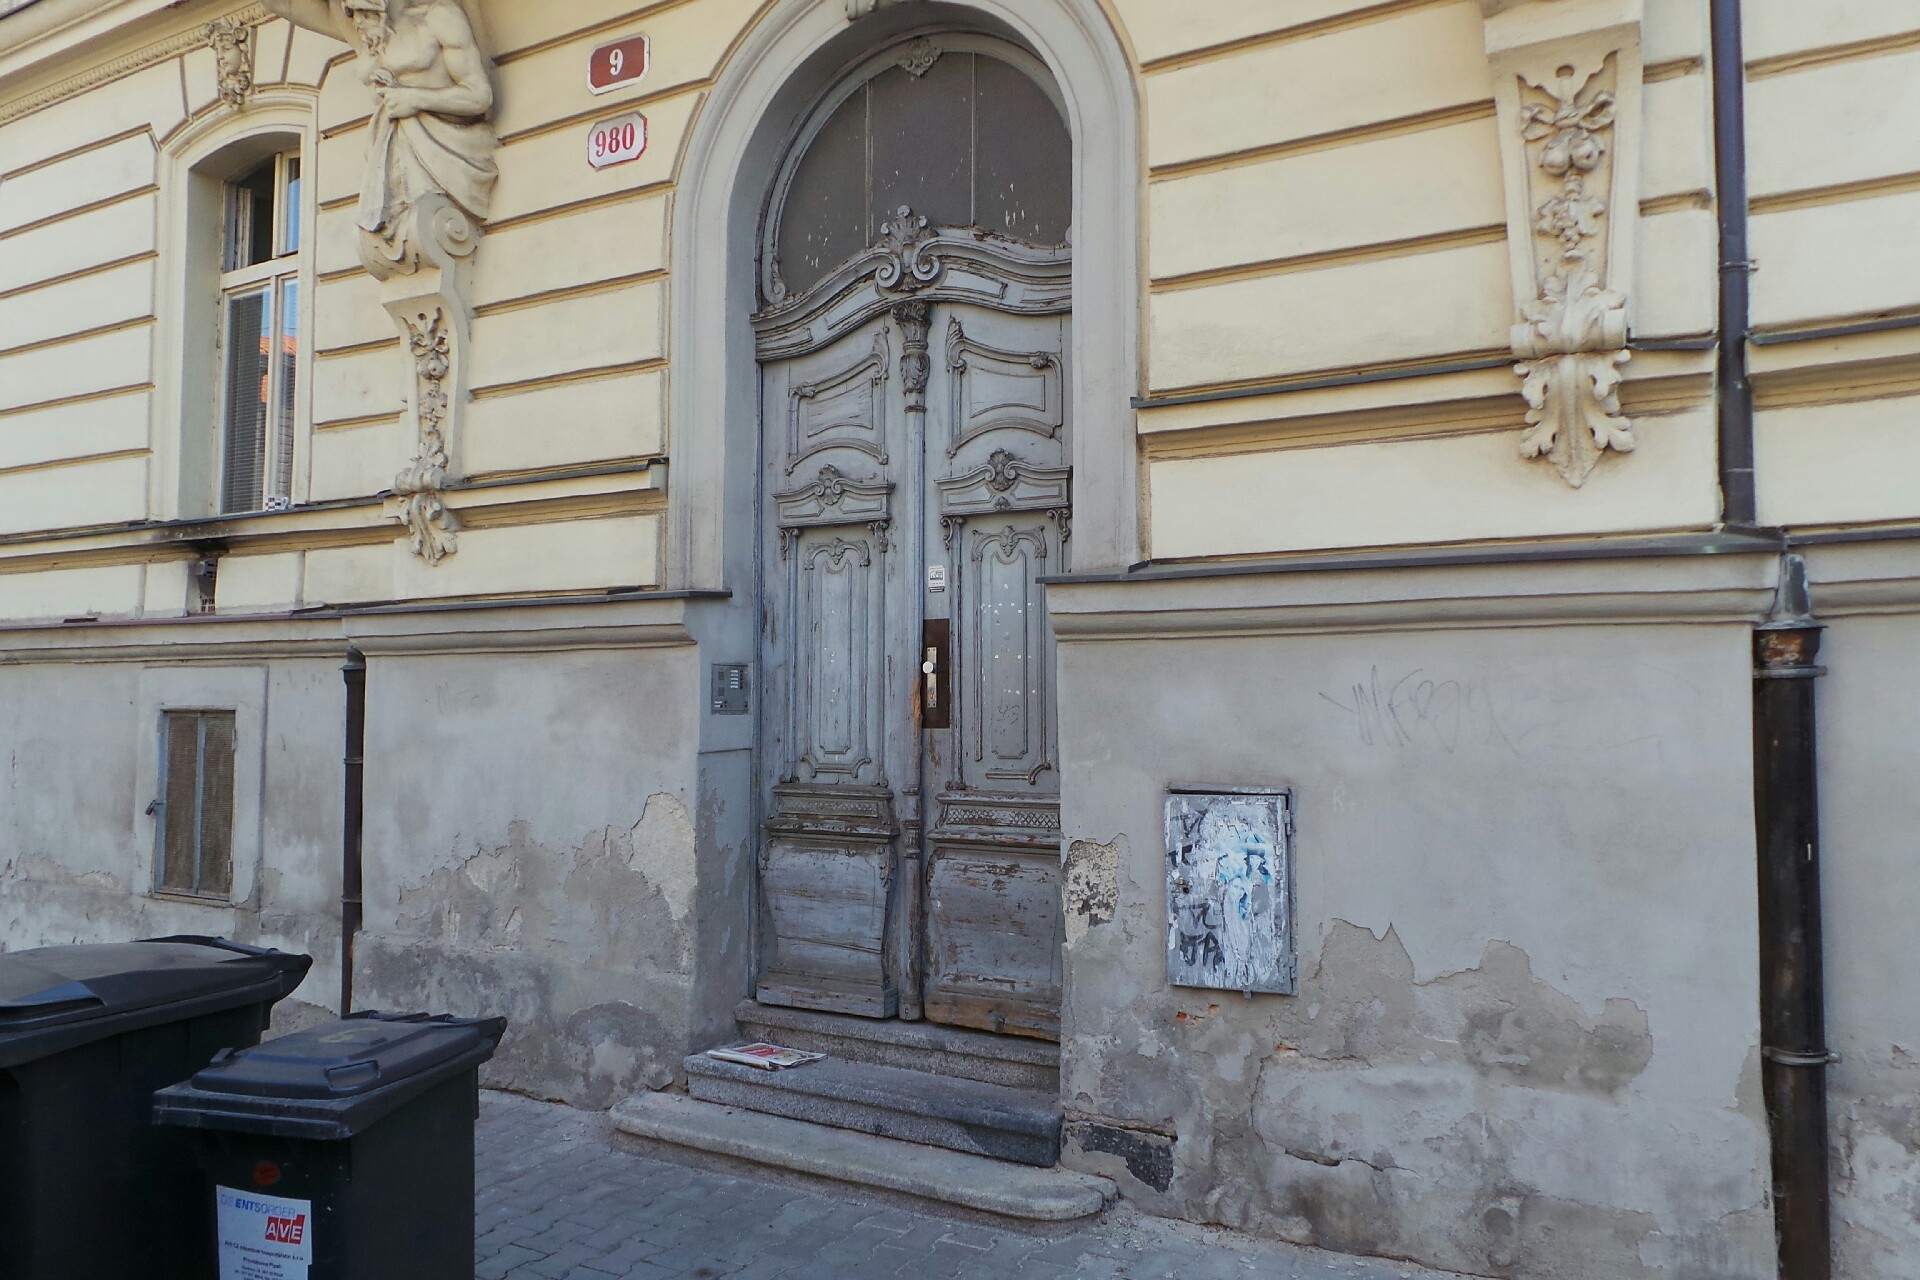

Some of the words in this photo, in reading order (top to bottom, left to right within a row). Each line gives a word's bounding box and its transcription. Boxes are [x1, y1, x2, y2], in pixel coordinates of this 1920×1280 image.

[609, 49, 623, 75] 9
[595, 122, 635, 158] 980
[266, 1222, 302, 1240] AVE
